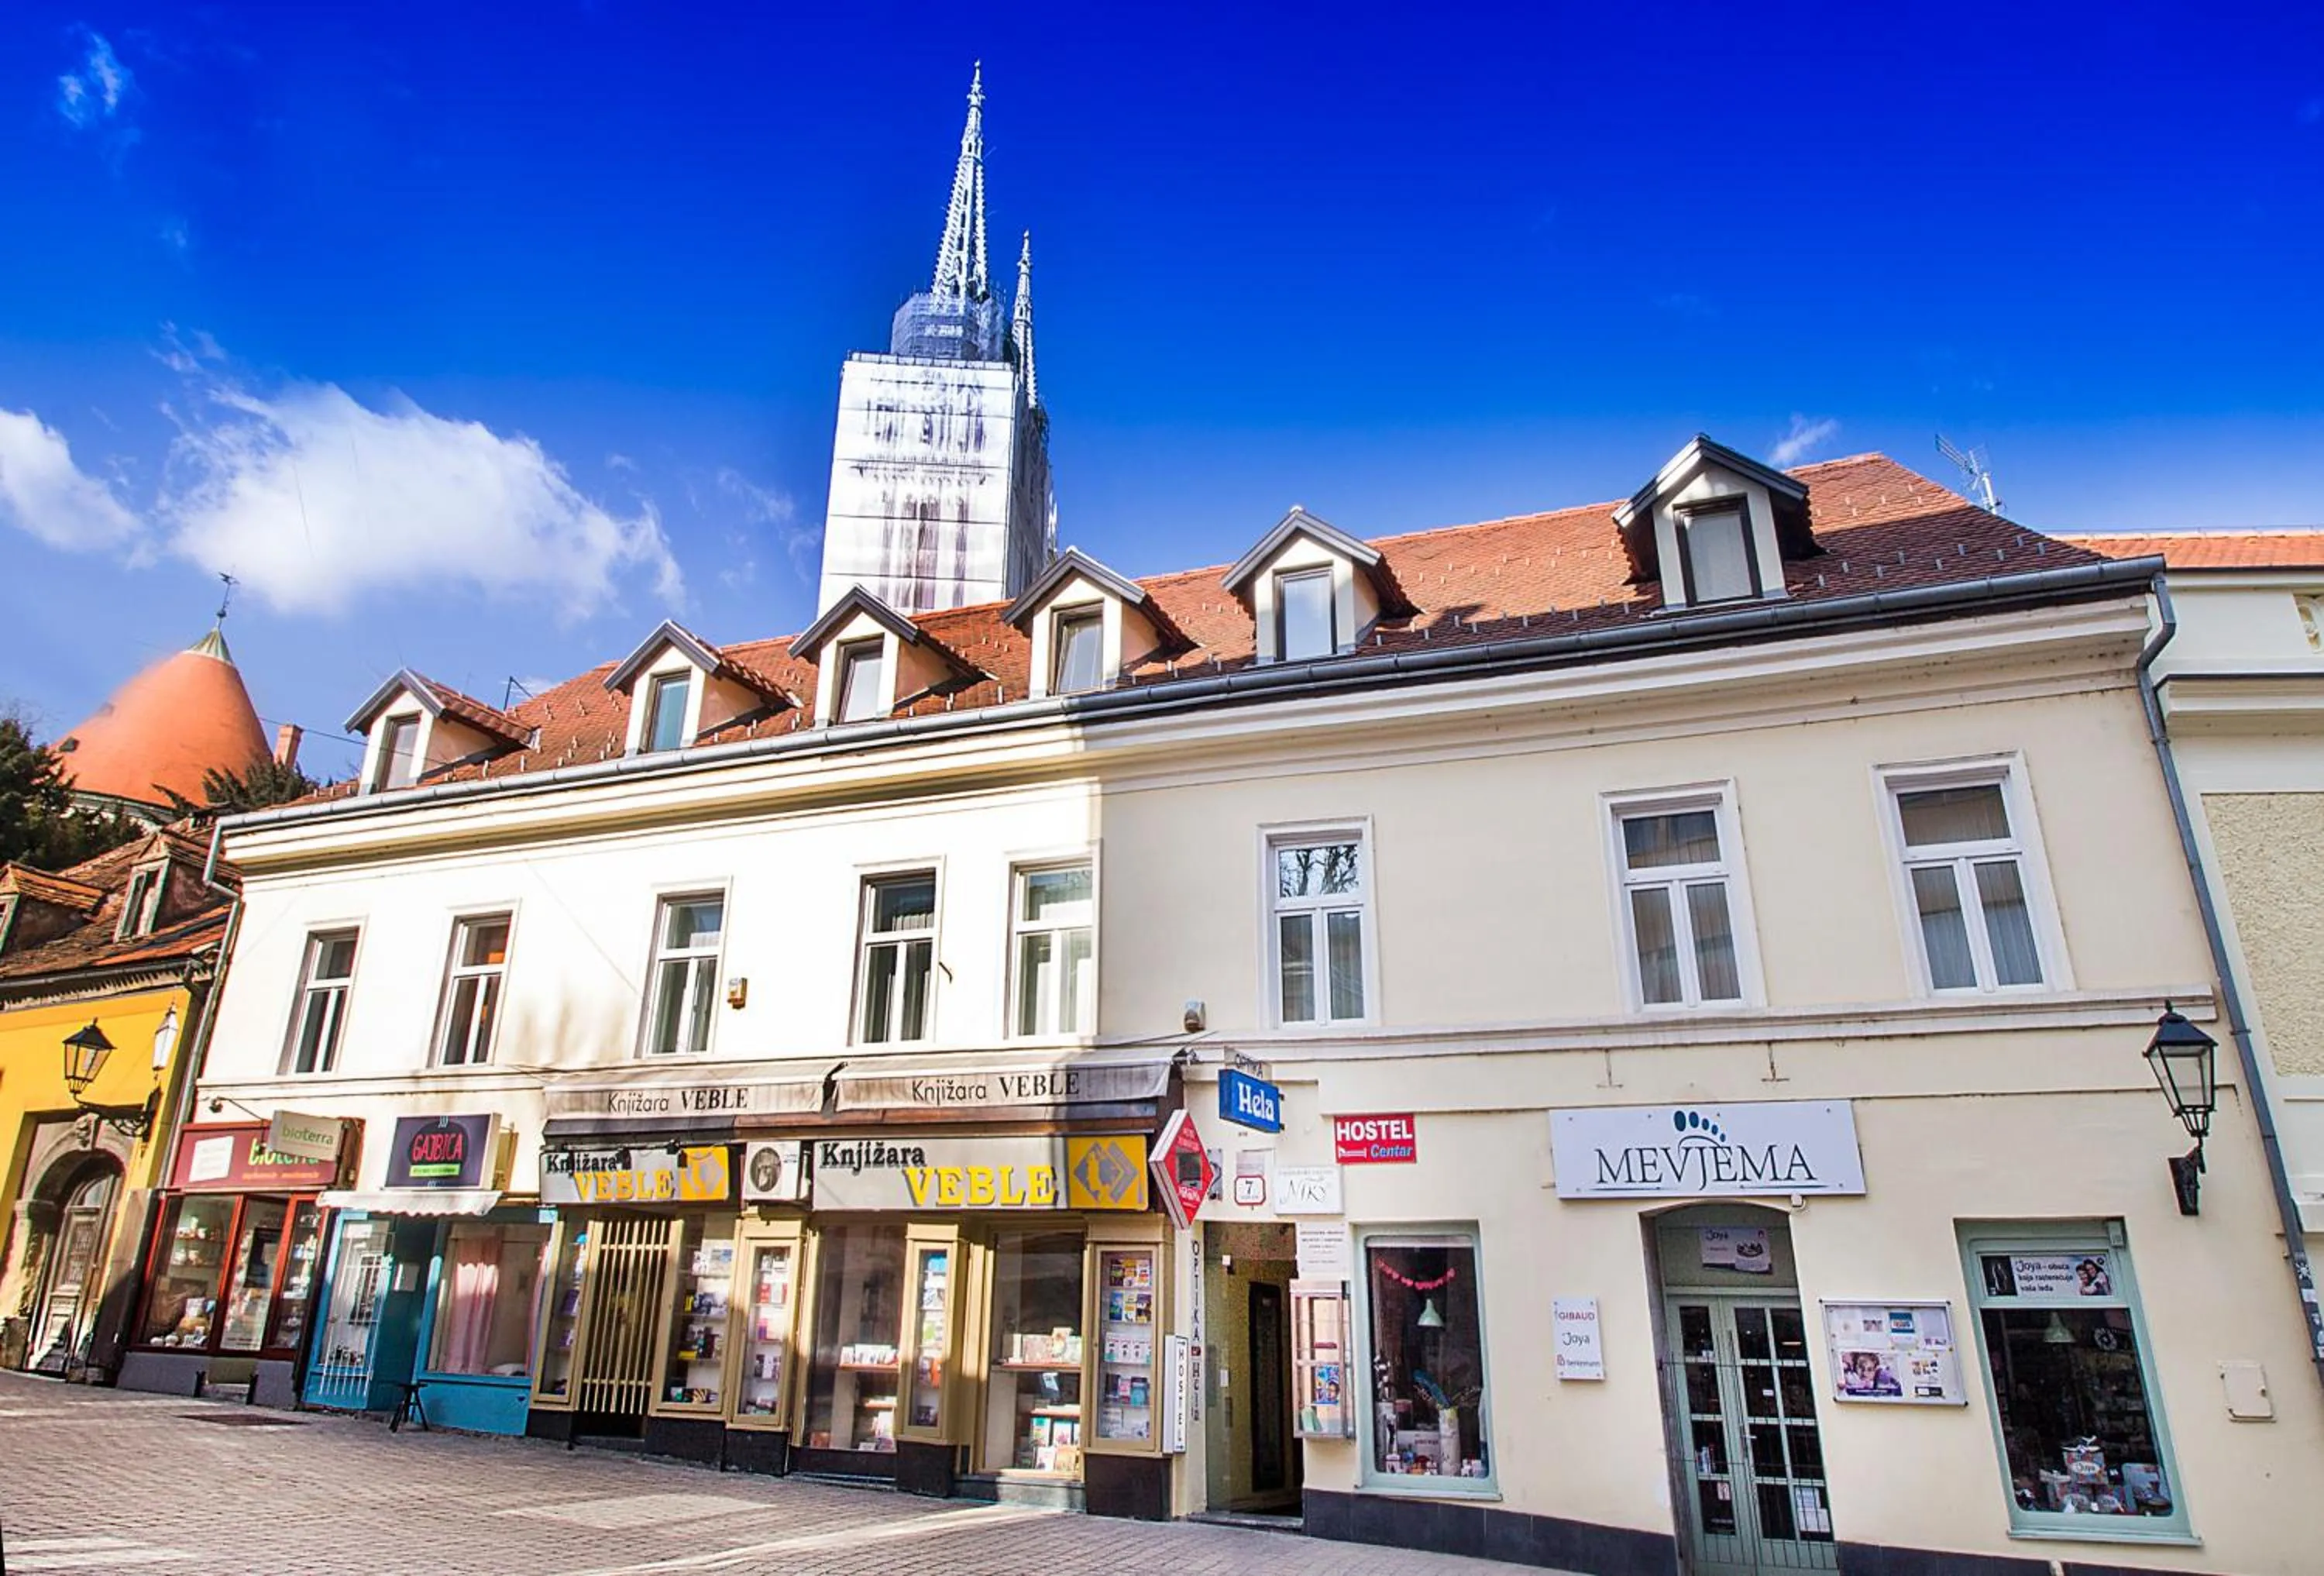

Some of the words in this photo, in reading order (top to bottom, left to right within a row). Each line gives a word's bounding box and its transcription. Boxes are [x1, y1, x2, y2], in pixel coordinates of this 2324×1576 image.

[607, 1091, 669, 1116] Knjižara
[681, 1087, 750, 1110] VEBLE
[912, 1079, 987, 1106] Knjižara
[999, 1072, 1080, 1098] VEBLE
[1237, 1081, 1274, 1122] Hela
[281, 1126, 334, 1146] bioterra
[1336, 1120, 1413, 1141] HOSTEL
[819, 1142, 927, 1177] Knjižara
[1594, 1144, 1818, 1191] MEVJEMA
[573, 1171, 676, 1201] VEBLE
[902, 1165, 1058, 1206] VEBLE
[1245, 1179, 1253, 1196] 7
[1562, 1332, 1590, 1347] Joya
